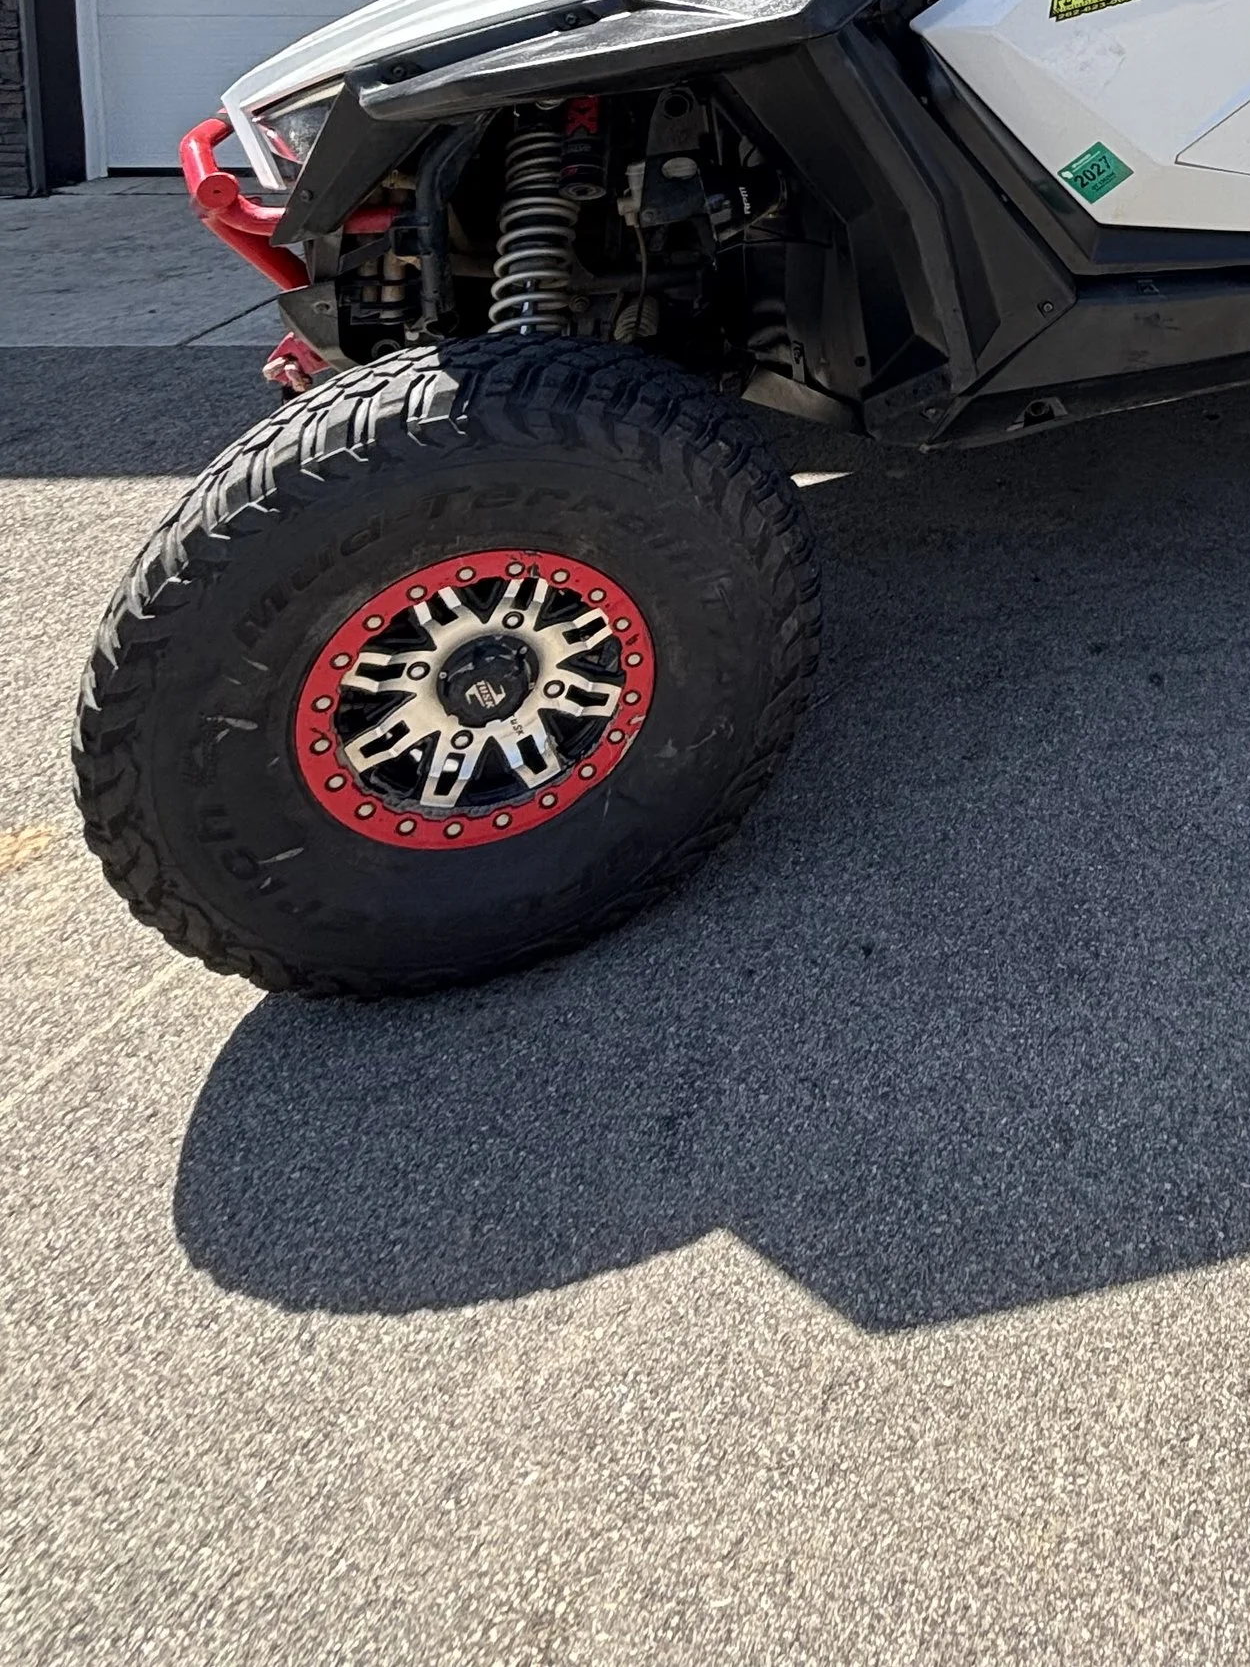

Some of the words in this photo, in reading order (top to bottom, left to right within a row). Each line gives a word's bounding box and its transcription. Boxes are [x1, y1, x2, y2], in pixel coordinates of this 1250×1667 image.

[1074, 155, 1111, 188] 2027
[476, 680, 495, 709] TUSK
[511, 715, 525, 735] USK
